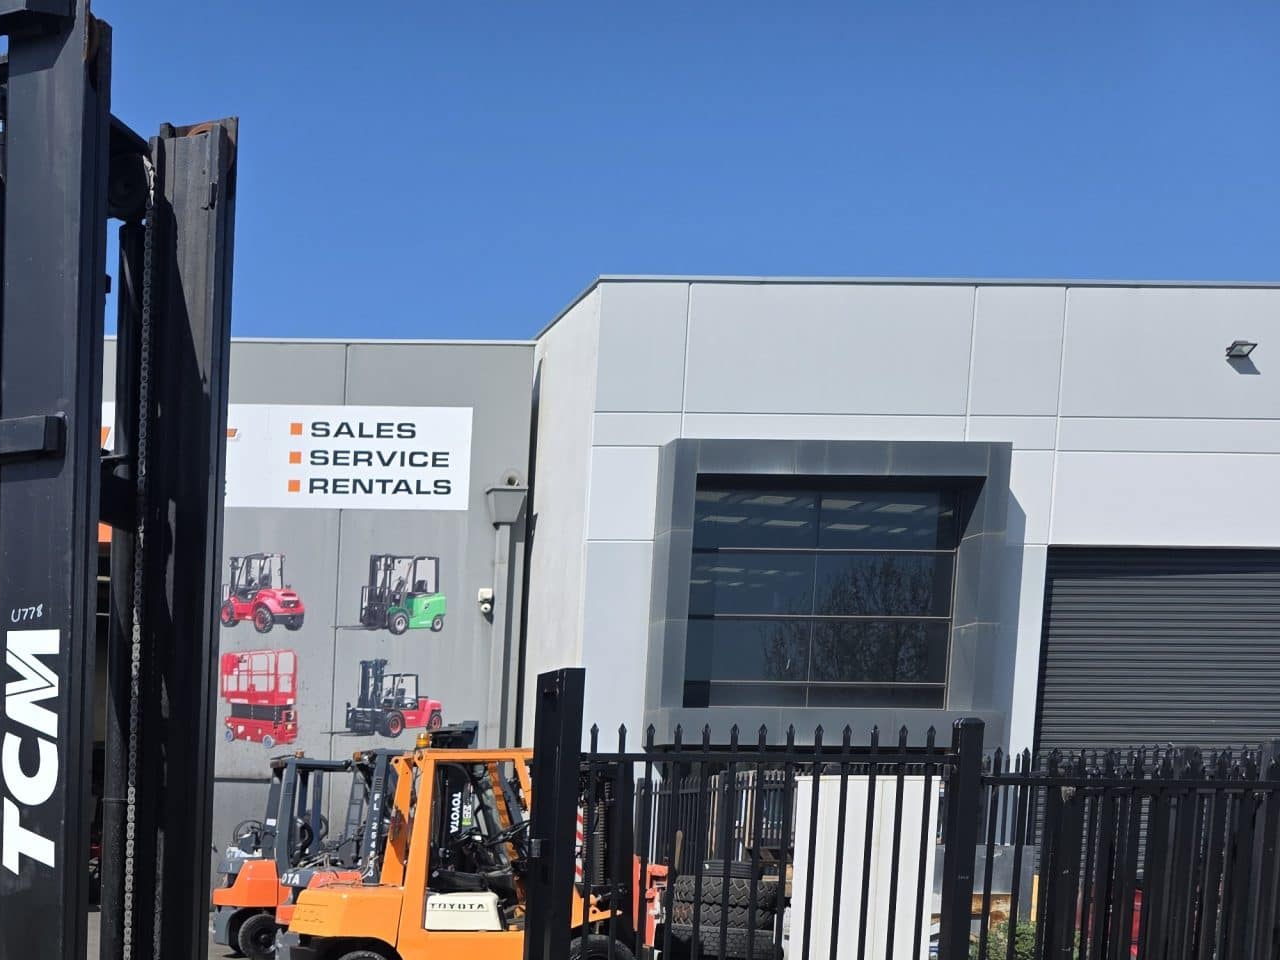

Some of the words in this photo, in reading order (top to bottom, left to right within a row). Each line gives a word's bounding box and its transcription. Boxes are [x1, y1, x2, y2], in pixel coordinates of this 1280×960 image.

[311, 421, 417, 439] SALES
[310, 449, 450, 468] SERVICE
[309, 477, 452, 495] RENTALS
[1, 629, 61, 876] TCM
[450, 791, 462, 834] TOYOTA
